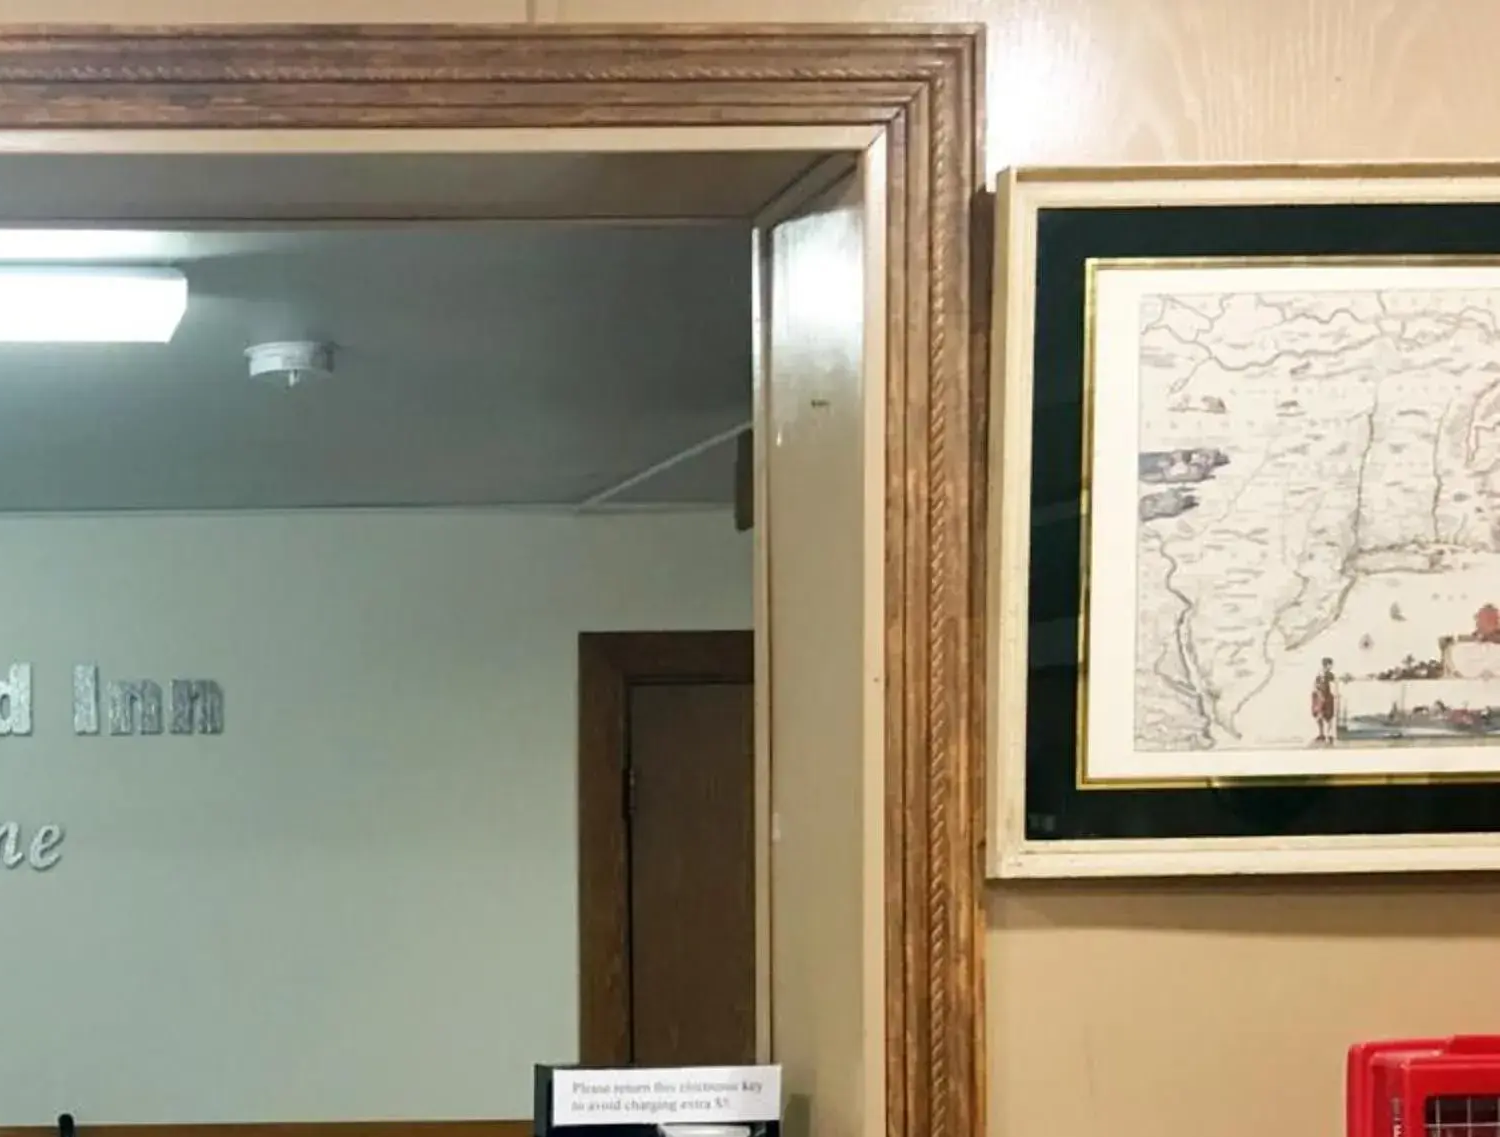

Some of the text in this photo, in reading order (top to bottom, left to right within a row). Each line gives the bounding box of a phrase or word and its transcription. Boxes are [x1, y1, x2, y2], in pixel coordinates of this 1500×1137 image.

[72, 663, 225, 736] Inn
[588, 1100, 621, 1111] avoid
[625, 1099, 677, 1114] charging
